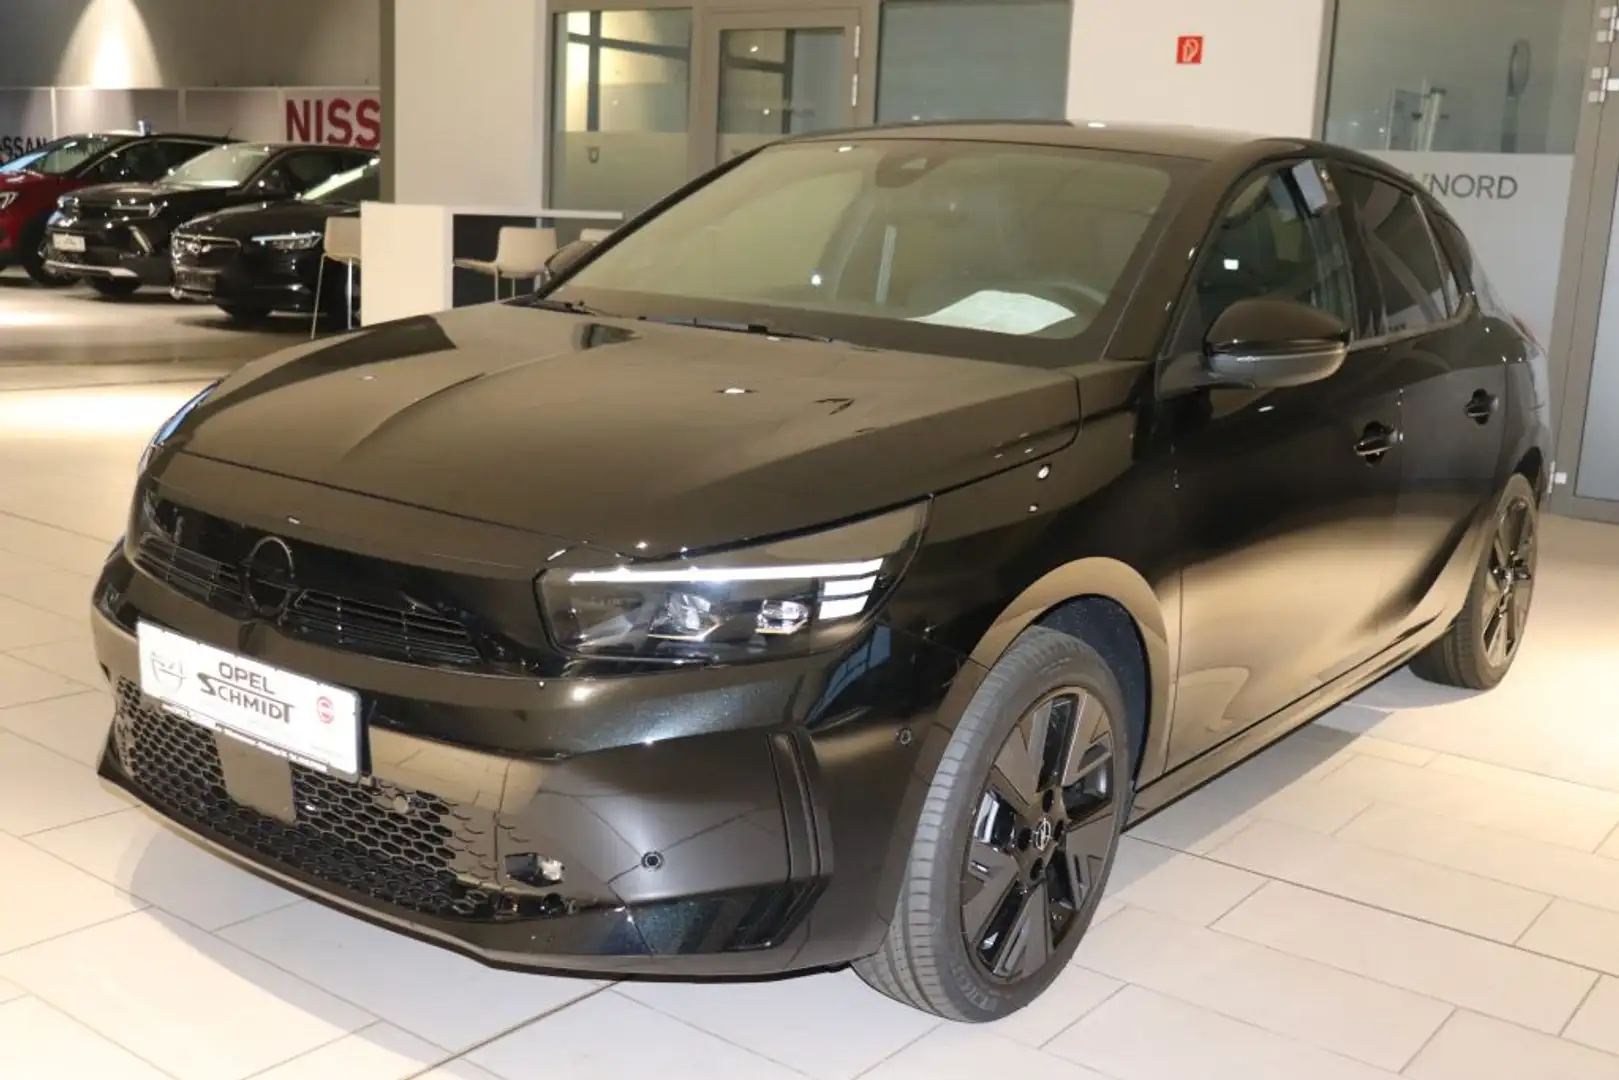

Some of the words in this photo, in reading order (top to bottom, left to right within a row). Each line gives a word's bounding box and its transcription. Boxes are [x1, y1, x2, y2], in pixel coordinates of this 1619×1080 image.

[286, 98, 381, 148] NISS
[1422, 172, 1518, 199] NORD
[197, 672, 295, 724] SCHMIDT
[218, 661, 276, 695] OPEL
